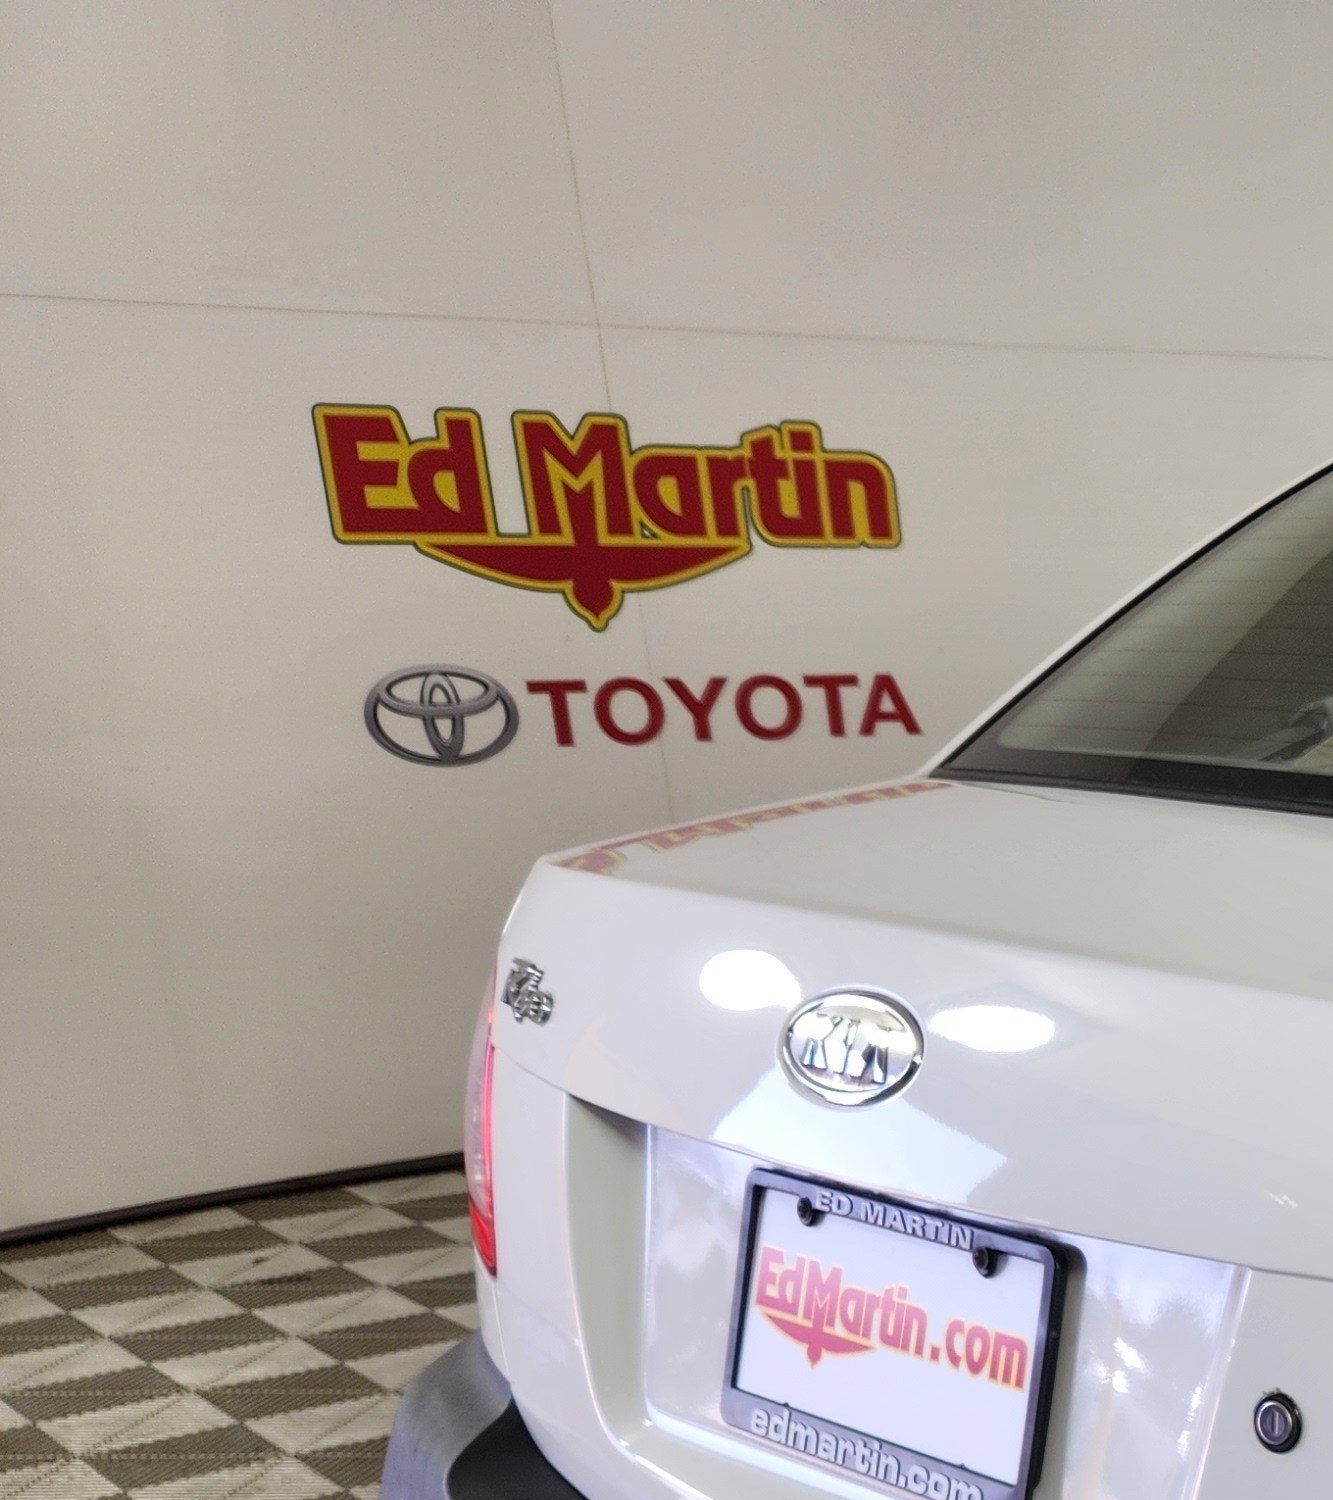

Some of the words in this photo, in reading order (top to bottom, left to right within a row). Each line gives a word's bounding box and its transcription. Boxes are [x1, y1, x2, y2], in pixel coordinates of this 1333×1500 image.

[312, 403, 499, 544] Ed
[511, 410, 901, 548] Martin
[526, 674, 923, 747] TOYOTA
[815, 1191, 853, 1218] ED
[859, 1201, 976, 1250] MARTIN
[756, 1244, 1029, 1393] EdMartin.com
